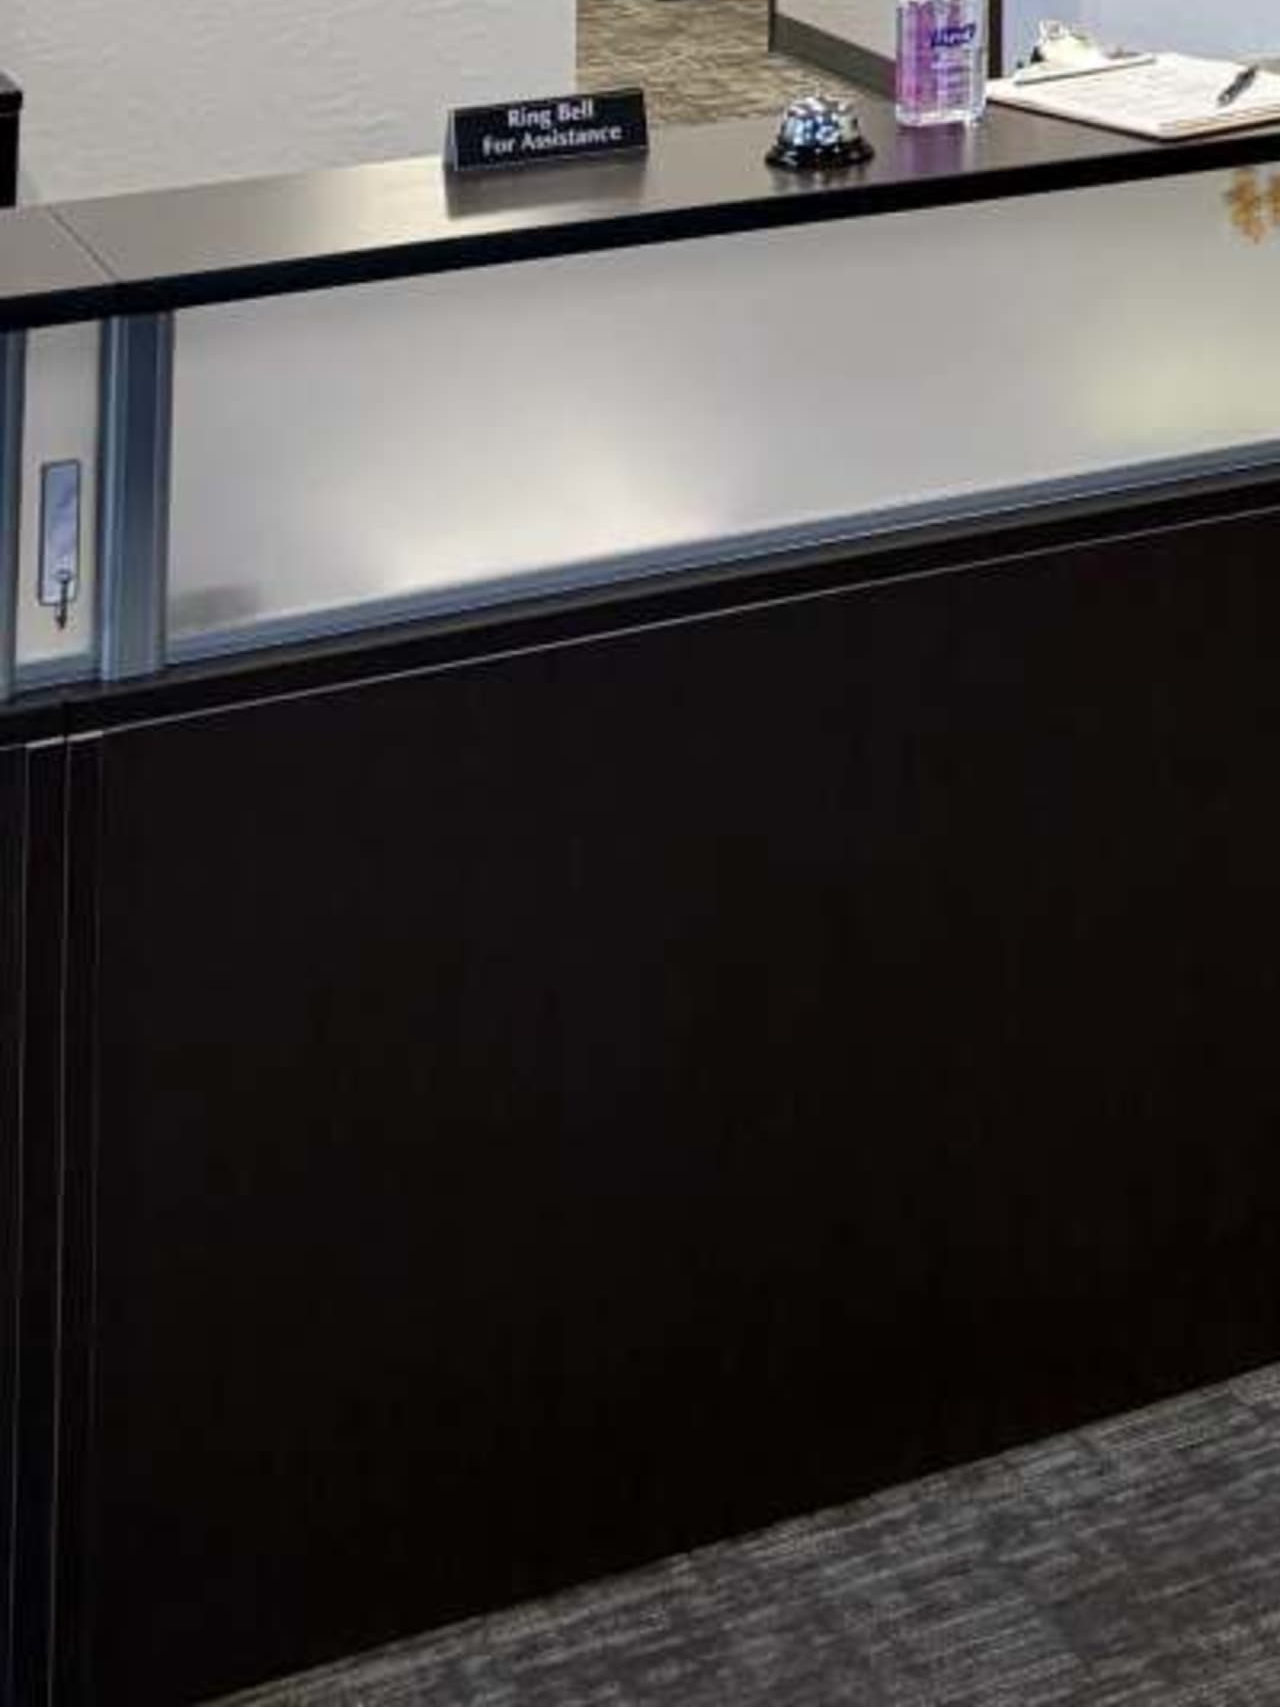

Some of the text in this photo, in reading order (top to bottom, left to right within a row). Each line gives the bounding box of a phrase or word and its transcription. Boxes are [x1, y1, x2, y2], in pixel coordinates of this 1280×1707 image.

[508, 98, 594, 130] Ring Bell
[482, 124, 623, 156] For Assistance
